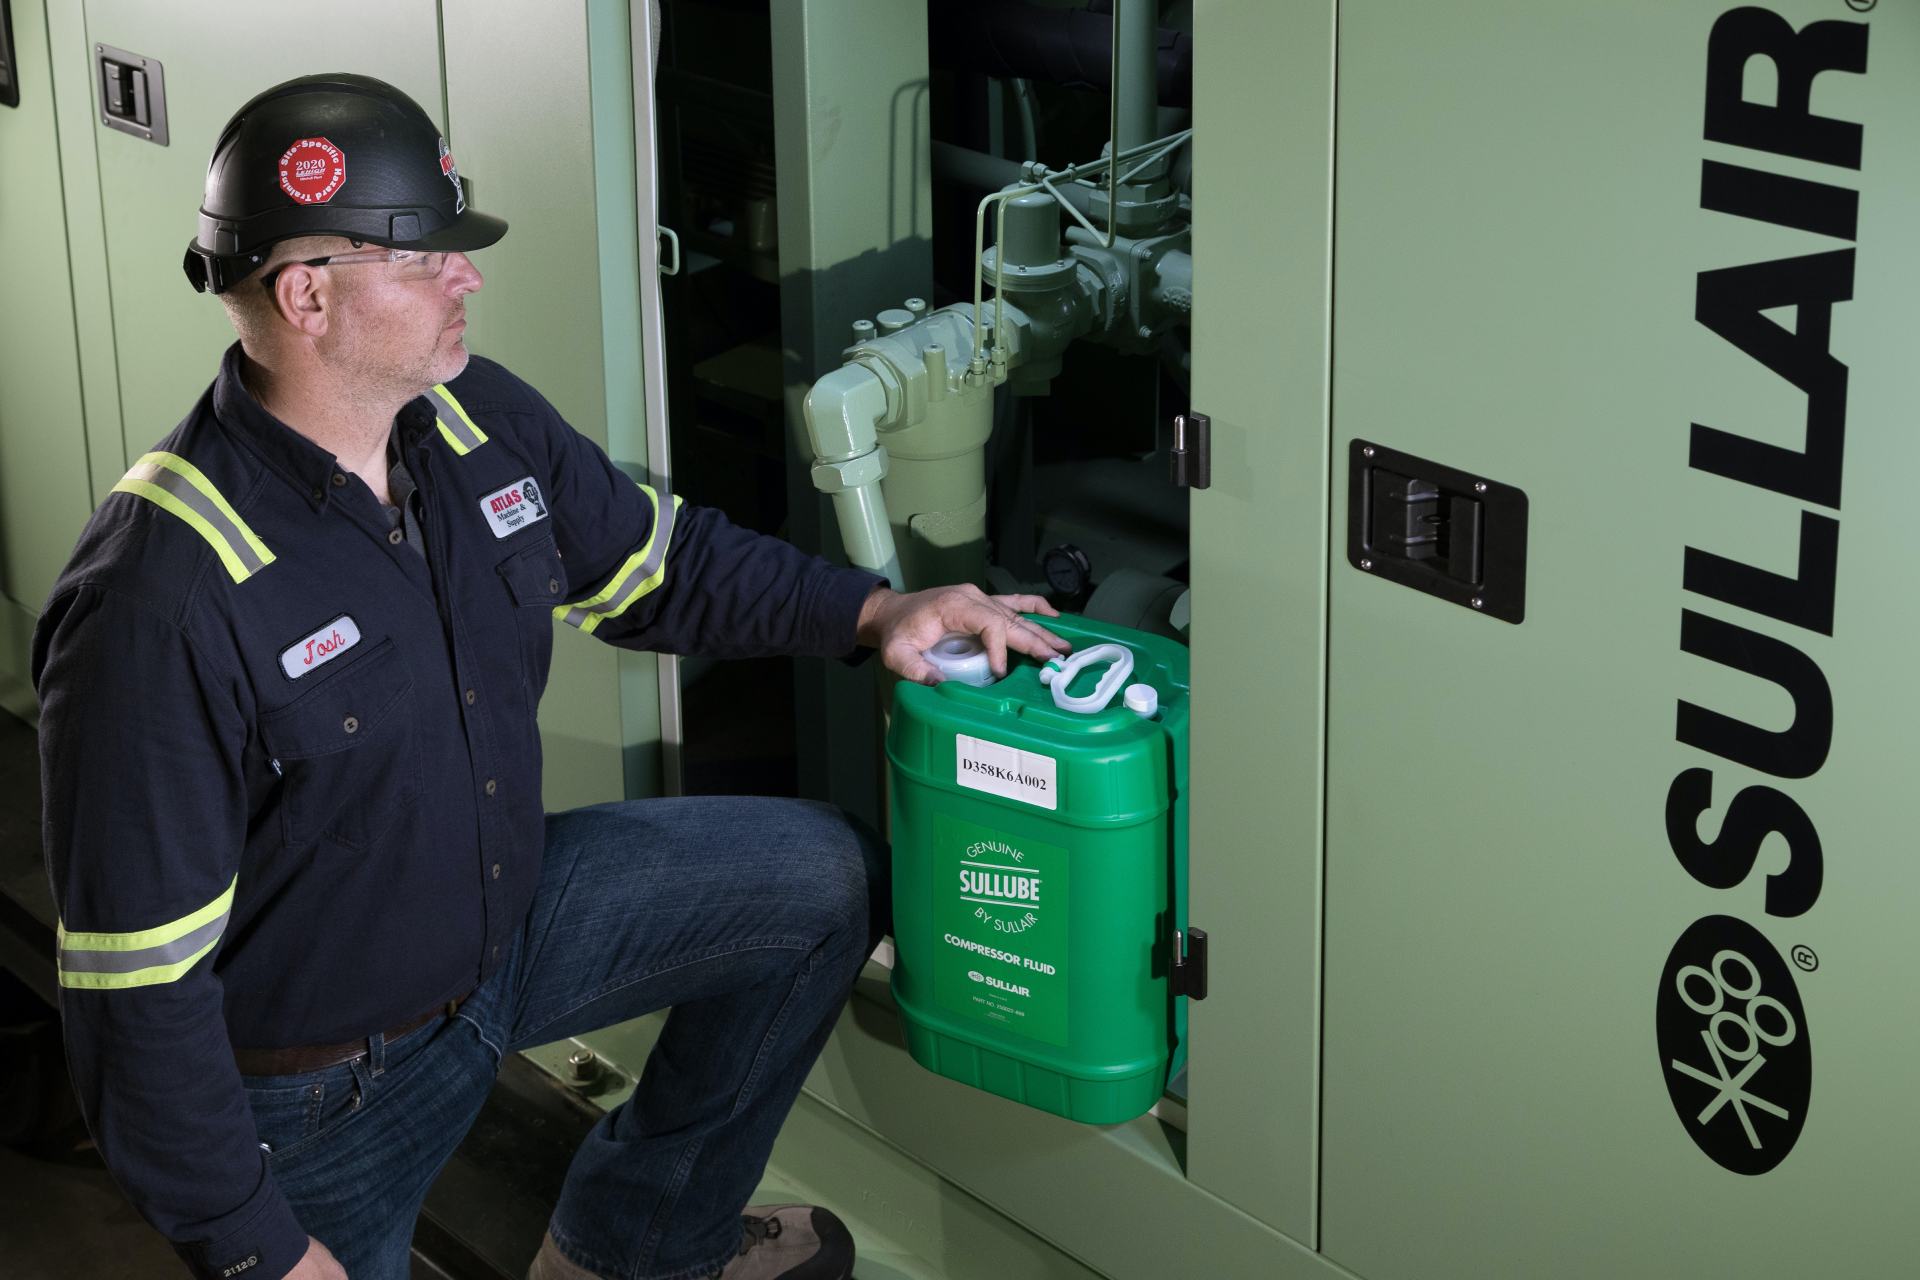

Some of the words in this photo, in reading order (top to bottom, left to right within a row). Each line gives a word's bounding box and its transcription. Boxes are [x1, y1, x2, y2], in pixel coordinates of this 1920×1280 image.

[281, 140, 339, 166] Site-Specific
[295, 159, 326, 171] 2020
[281, 170, 312, 202] Training
[315, 168, 342, 201] Hazard
[1664, 6, 1870, 918] SULLAIR
[490, 489, 522, 514] ATLAS
[496, 507, 520, 522] Machine
[520, 503, 526, 511] &
[506, 514, 525, 528] Supply
[303, 629, 346, 665] Josh
[963, 758, 1047, 791] D358K6A002
[966, 840, 1025, 863] GENUINE
[959, 869, 1040, 901] SULLUBE
[974, 906, 992, 924] BY
[993, 912, 1038, 933] SULLAIR
[944, 933, 1022, 966] COMPRESSOR
[1023, 957, 1056, 976] FLUID
[985, 975, 1031, 998] SULLAIR
[223, 1260, 249, 1278] 2112
